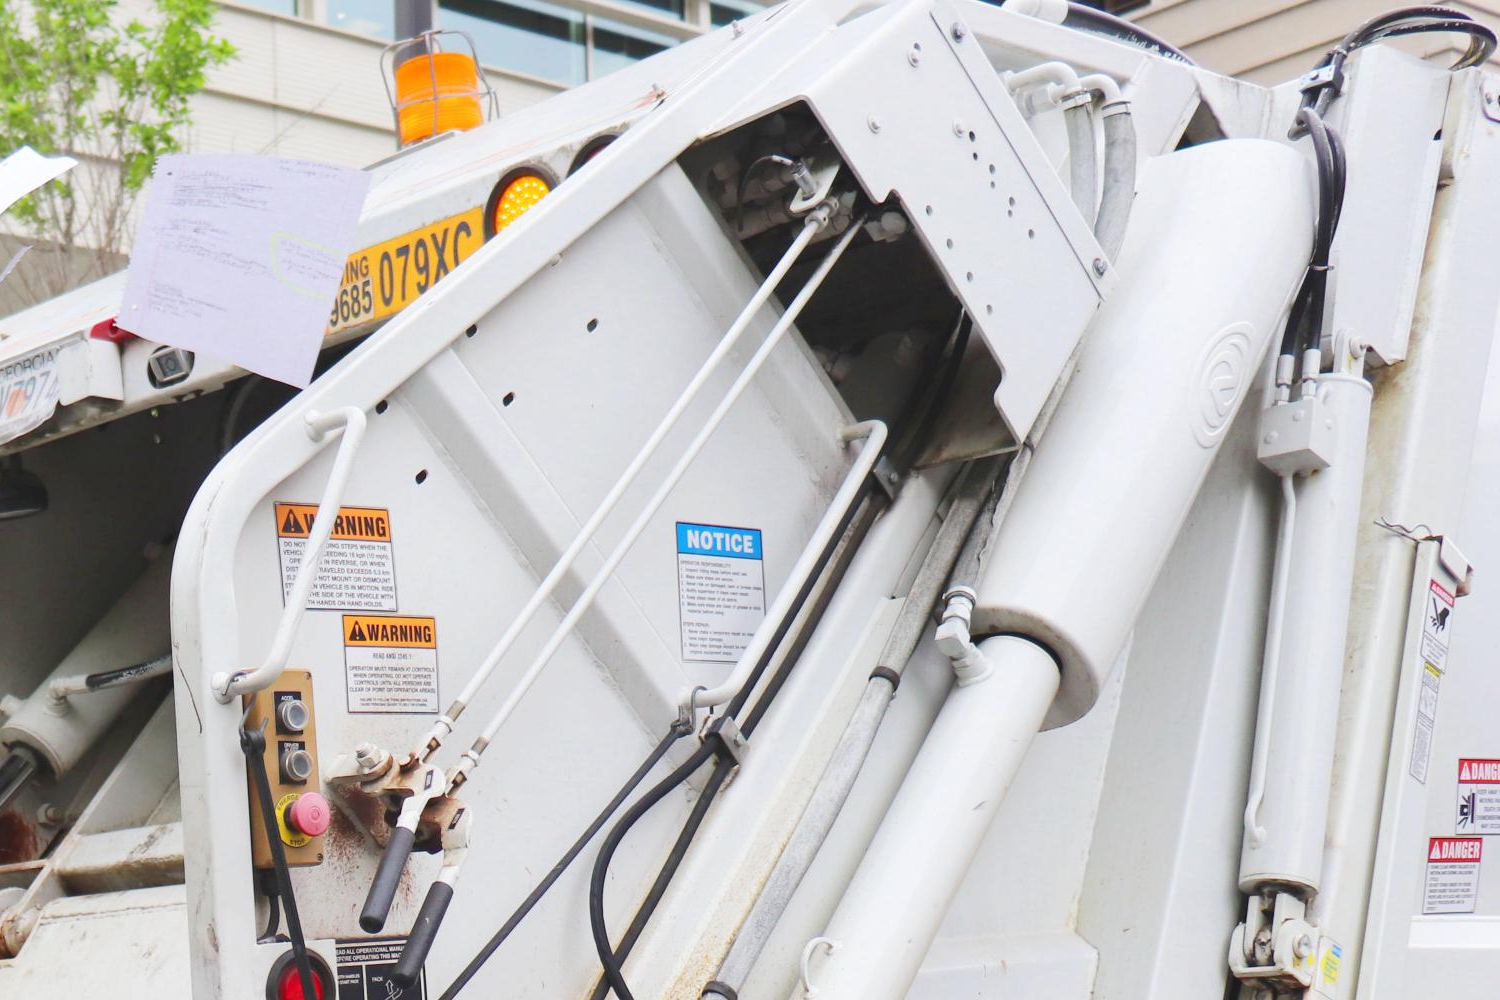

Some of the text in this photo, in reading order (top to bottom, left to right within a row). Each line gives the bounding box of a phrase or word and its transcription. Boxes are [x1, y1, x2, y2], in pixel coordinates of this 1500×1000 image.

[341, 256, 369, 285] ING
[0, 350, 54, 382] GEORGIA
[303, 513, 387, 537] WRNING
[686, 529, 754, 553] NOTICE
[366, 624, 432, 643] WARNING
[1442, 842, 1480, 858] DANGER
